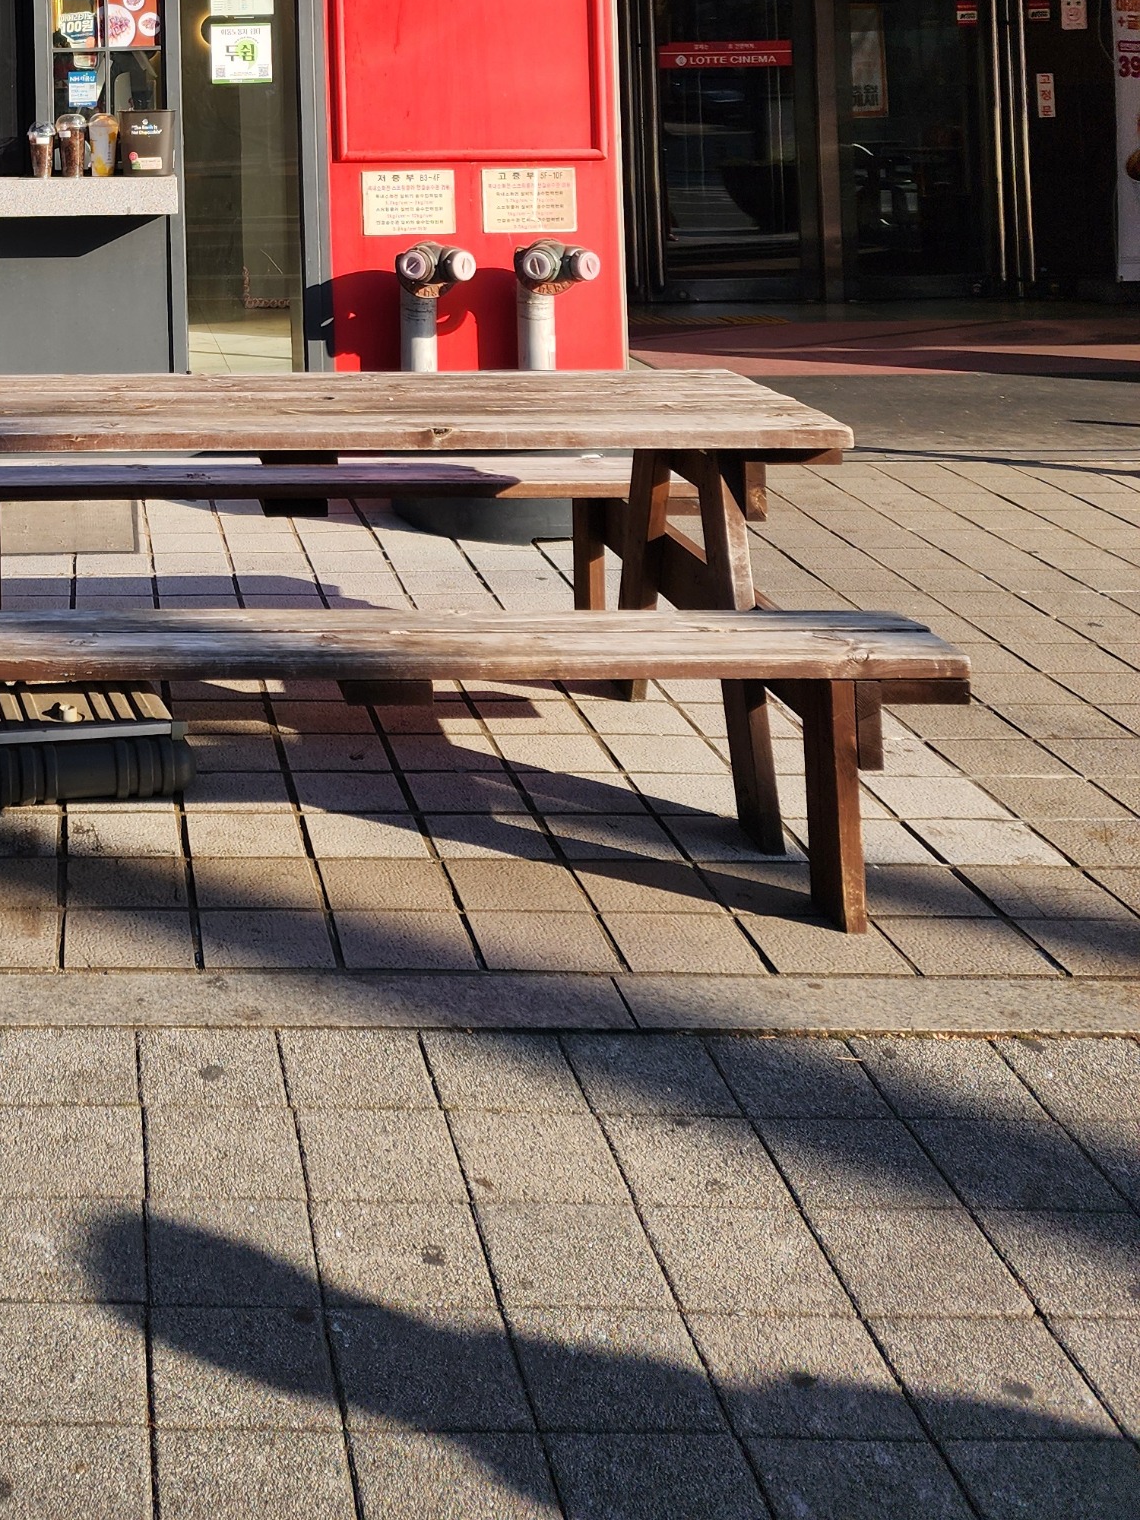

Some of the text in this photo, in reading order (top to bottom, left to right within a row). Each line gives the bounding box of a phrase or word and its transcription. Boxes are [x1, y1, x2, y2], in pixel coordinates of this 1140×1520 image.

[60, 20, 94, 33] 100원
[690, 55, 777, 65] LOTTE CINEMA
[1039, 74, 1054, 117] 고정문
